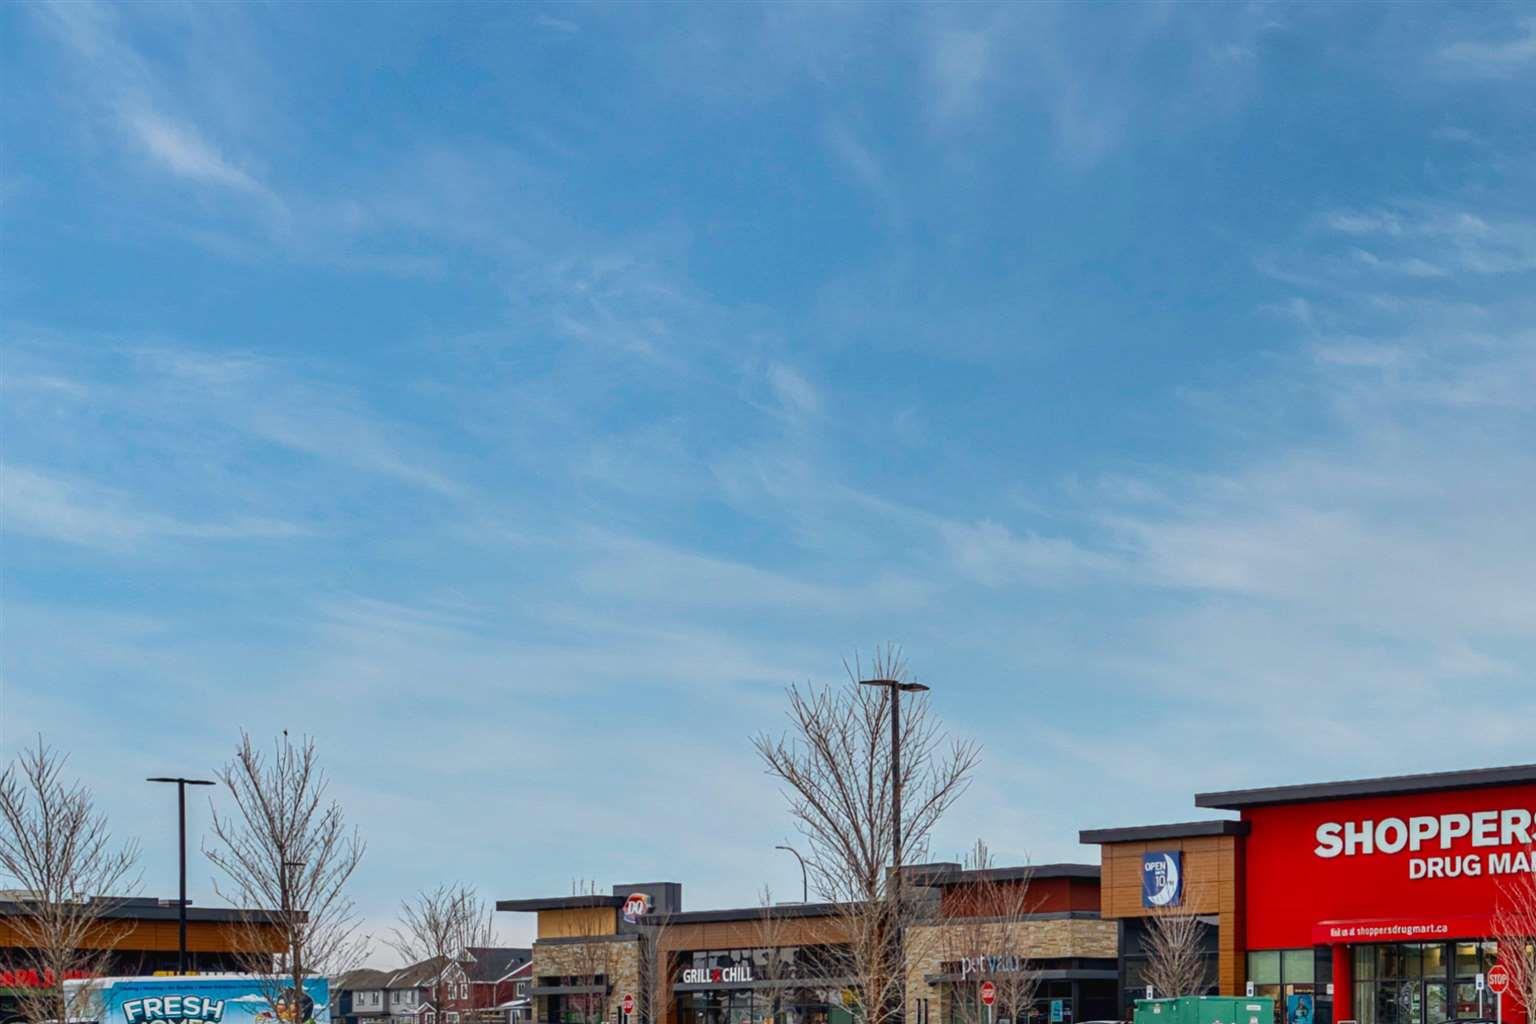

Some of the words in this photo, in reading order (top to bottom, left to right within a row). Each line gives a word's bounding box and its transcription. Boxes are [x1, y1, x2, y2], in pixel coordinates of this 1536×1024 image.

[1144, 861, 1166, 872] OPEN
[1409, 855, 1481, 880] DRUG
[1155, 874, 1166, 888] 10
[1357, 924, 1448, 937] shoppersdrugmart.ca
[683, 968, 712, 984] GRILL
[722, 966, 753, 983] CHILL
[1489, 974, 1507, 985] STOP
[123, 995, 225, 1022] FRESH
